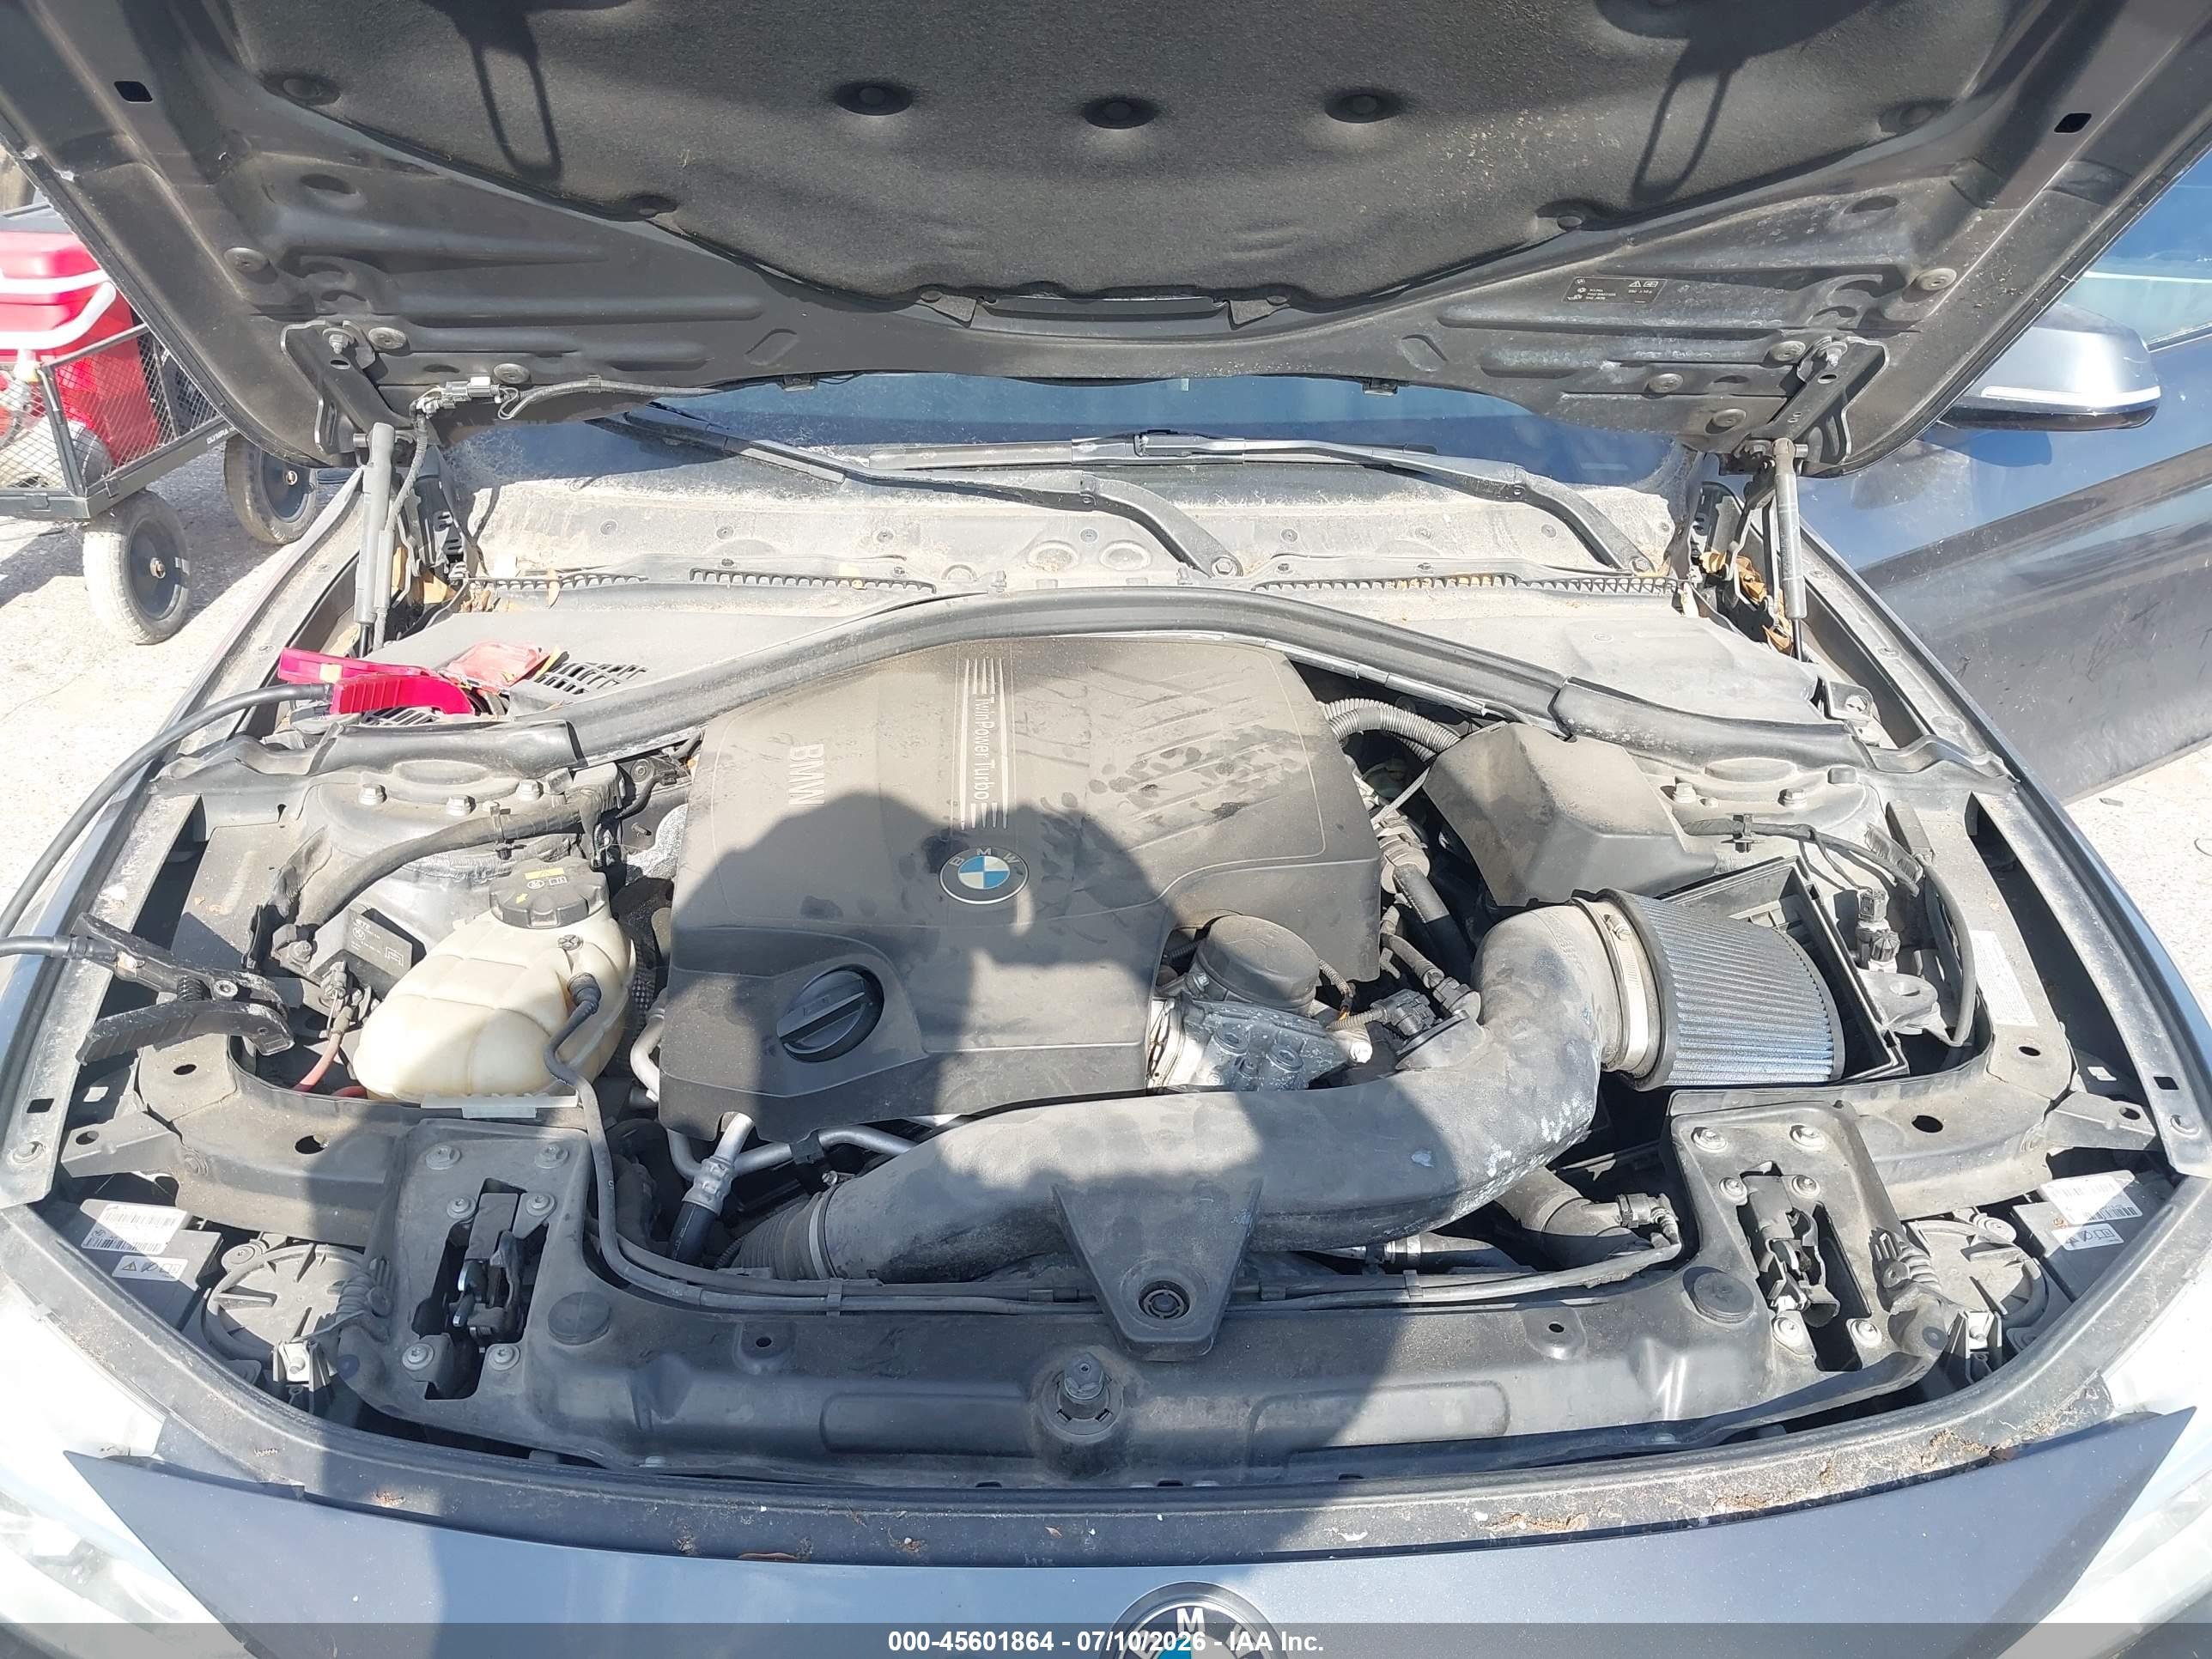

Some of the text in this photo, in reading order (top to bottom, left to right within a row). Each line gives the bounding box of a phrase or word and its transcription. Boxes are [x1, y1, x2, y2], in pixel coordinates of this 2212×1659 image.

[789, 744, 824, 805] BMW
[974, 696, 995, 801] TwinPower Turbo
[949, 848, 1020, 866] BMW
